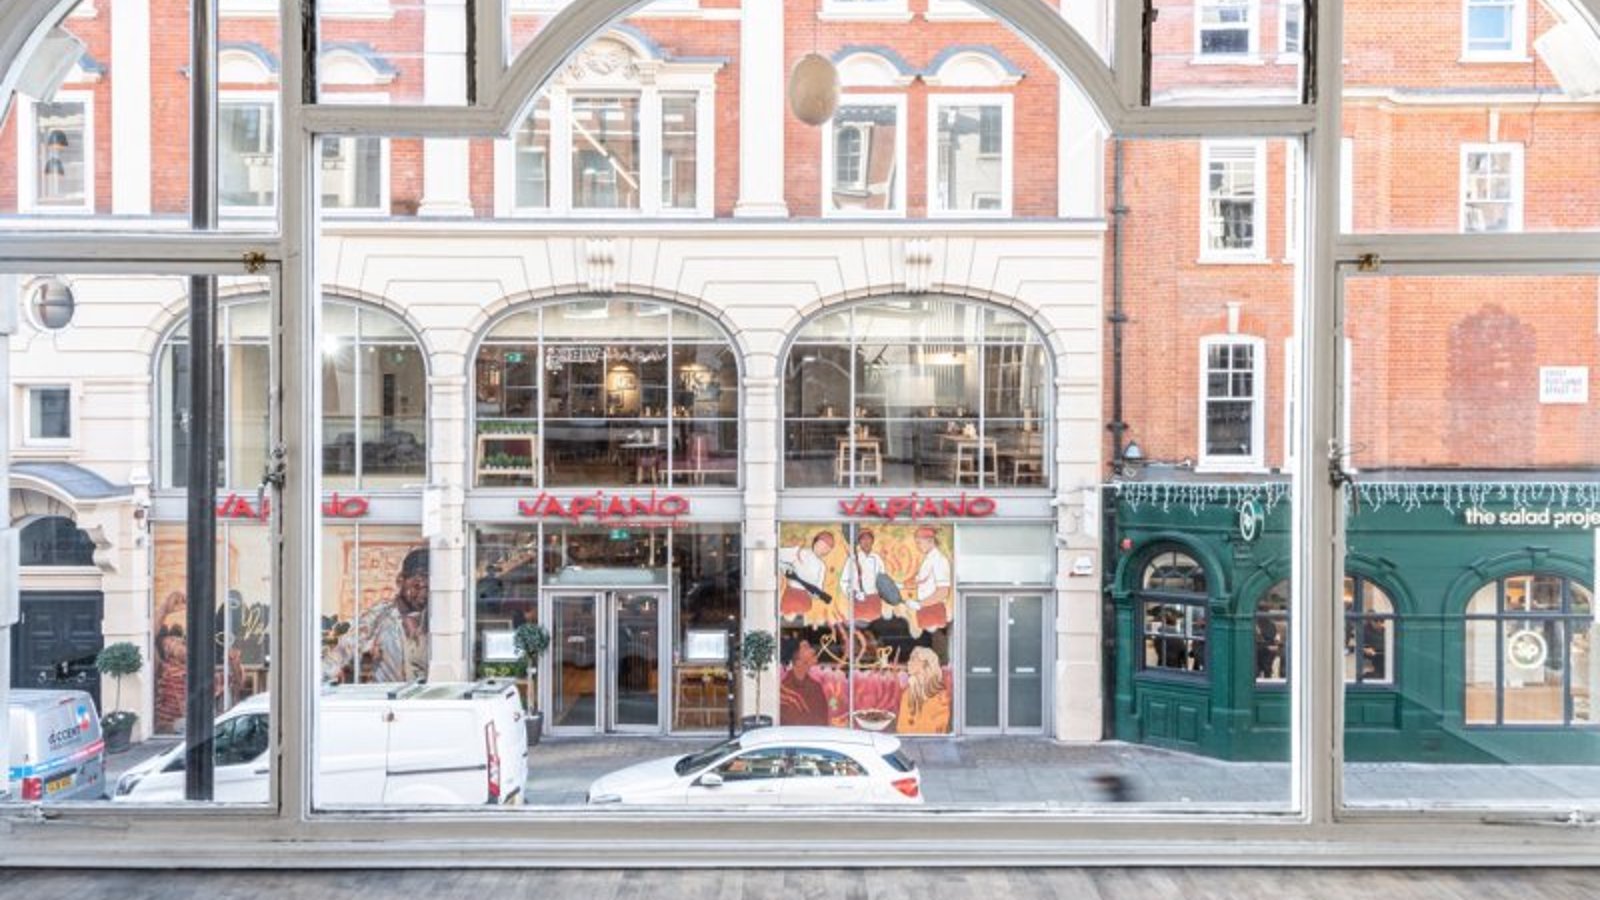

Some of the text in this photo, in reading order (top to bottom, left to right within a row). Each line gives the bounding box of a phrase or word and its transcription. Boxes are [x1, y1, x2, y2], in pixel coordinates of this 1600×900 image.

[518, 489, 690, 525] VAPIANO
[838, 492, 997, 521] VAPIANO
[1465, 507, 1496, 525] the
[1499, 507, 1551, 525] salad
